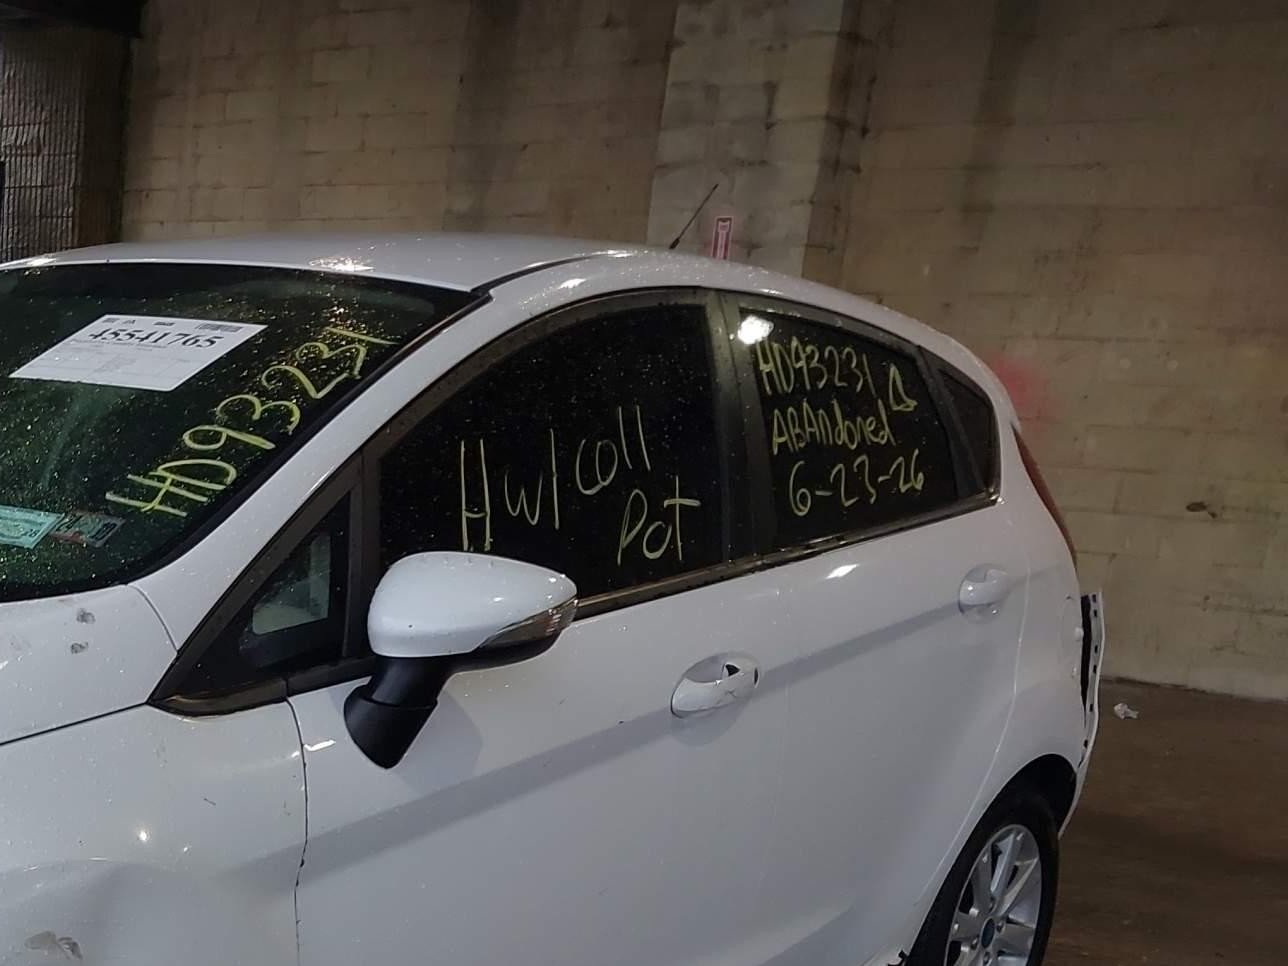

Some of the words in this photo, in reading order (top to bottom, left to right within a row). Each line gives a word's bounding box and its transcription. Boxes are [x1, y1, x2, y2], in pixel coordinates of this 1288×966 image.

[88, 327, 225, 348] 45541765
[105, 326, 401, 517] HD93231
[789, 448, 925, 517] 6-23-26
